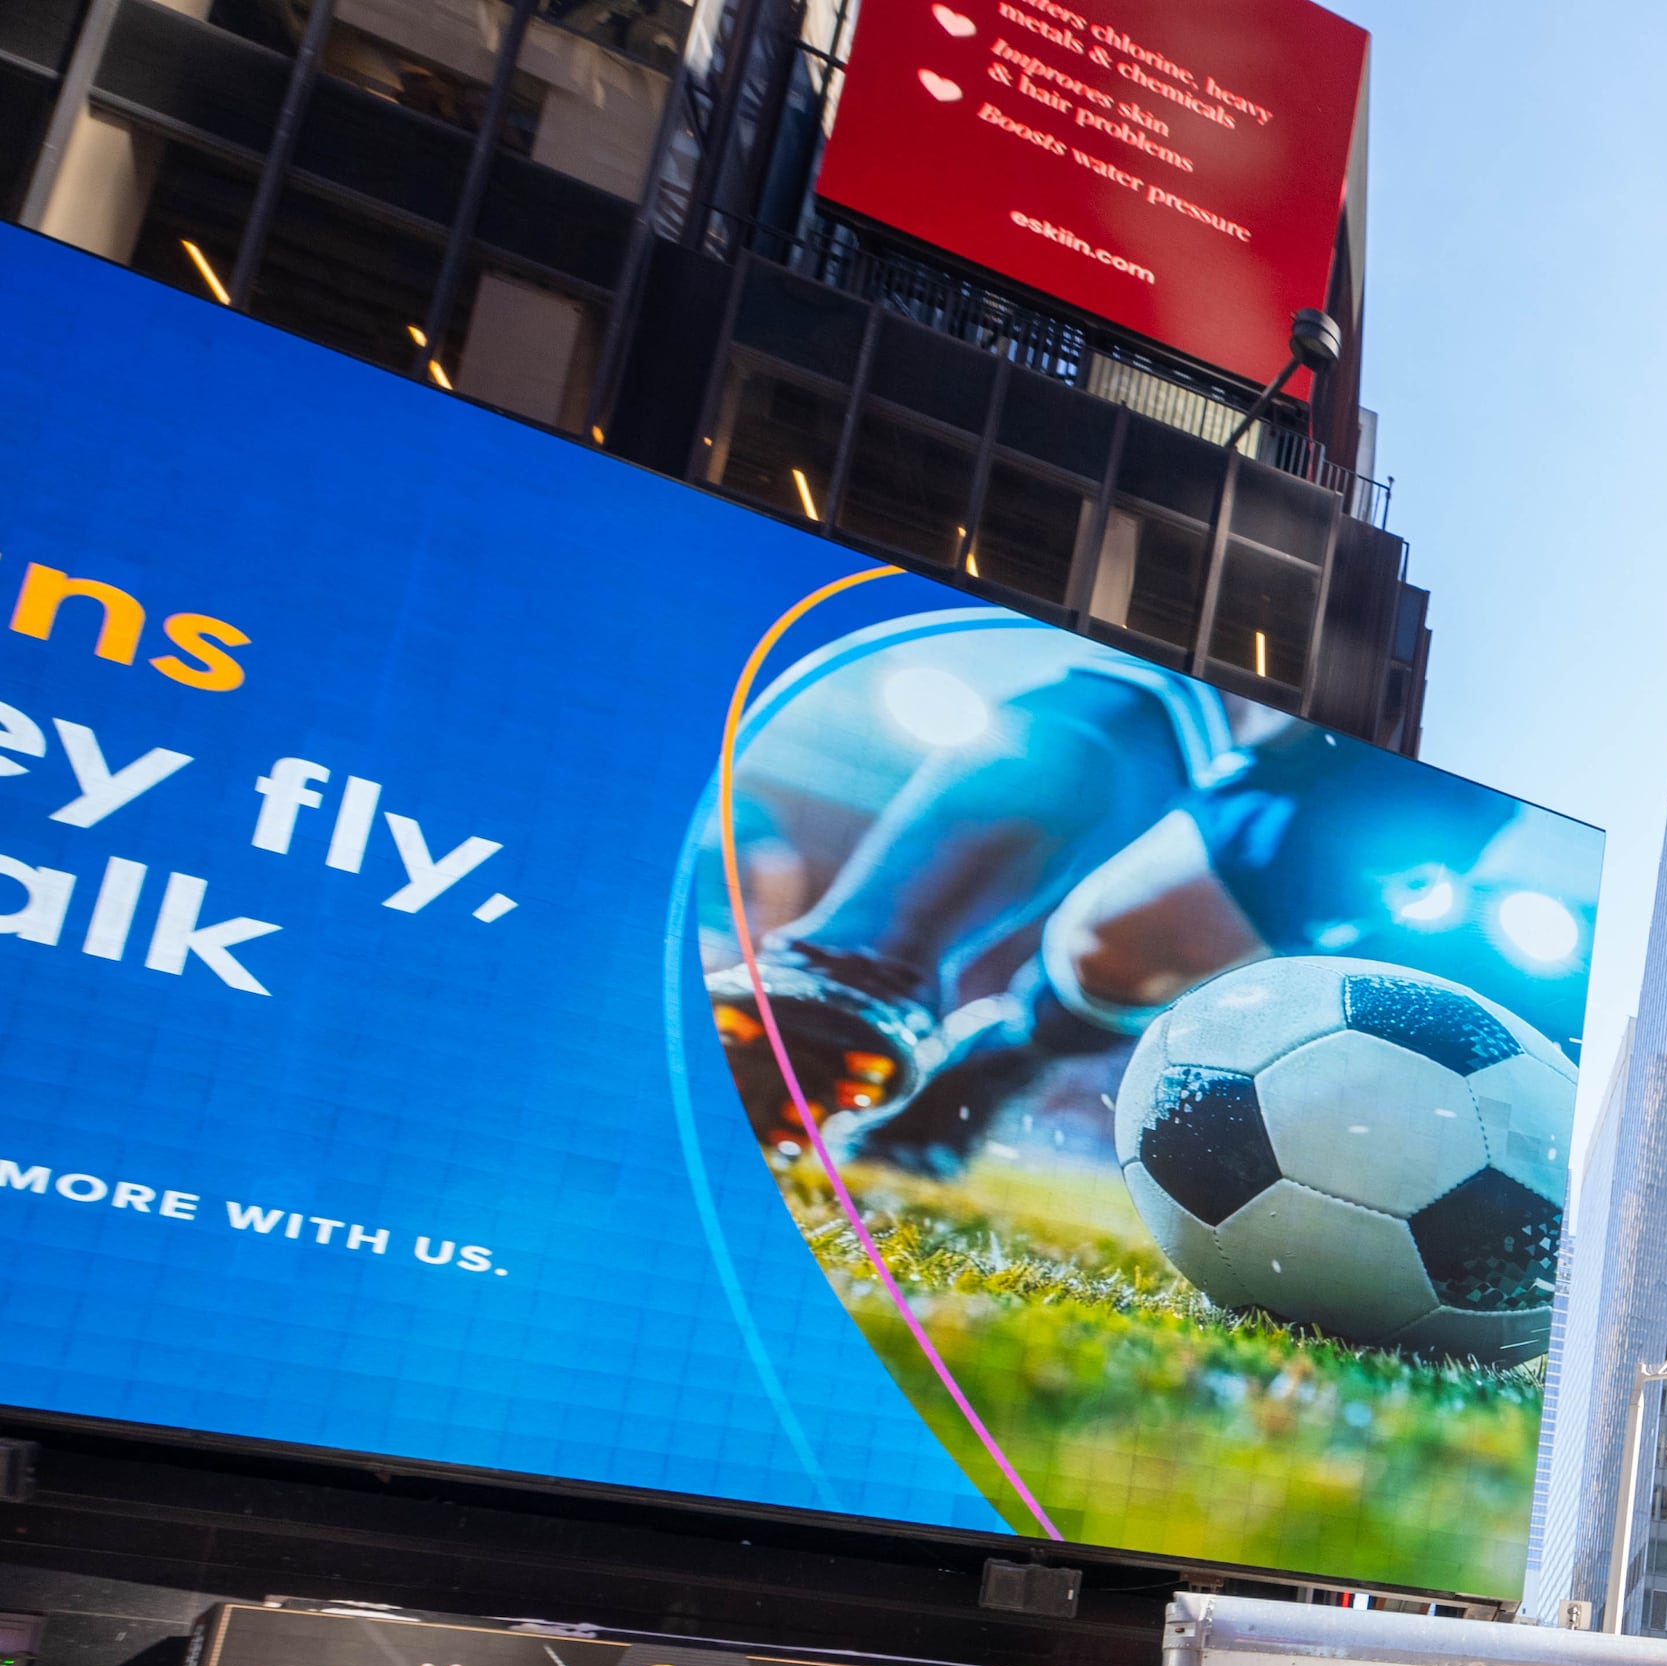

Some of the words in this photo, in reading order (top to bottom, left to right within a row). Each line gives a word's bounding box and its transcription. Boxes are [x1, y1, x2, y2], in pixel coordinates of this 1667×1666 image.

[987, 62, 1013, 87] &
[1018, 74, 1073, 114] hair
[1075, 106, 1194, 173] problems
[990, 37, 1114, 109] Improves
[1117, 101, 1169, 137] skin
[999, 2, 1084, 55] metals
[1088, 45, 1113, 70] &
[1117, 62, 1236, 129] chemicals
[1090, 24, 1199, 90] chlorine,
[1204, 76, 1274, 126] heavy
[976, 102, 1068, 155] Boosts
[1071, 147, 1144, 192] water
[1147, 184, 1252, 242] pressure
[1010, 210, 1155, 285] eskiin.com
[251, 757, 519, 923] fly,
[0, 1160, 201, 1221] MORE
[226, 1200, 390, 1256] WITH
[413, 1234, 508, 1277] US.
